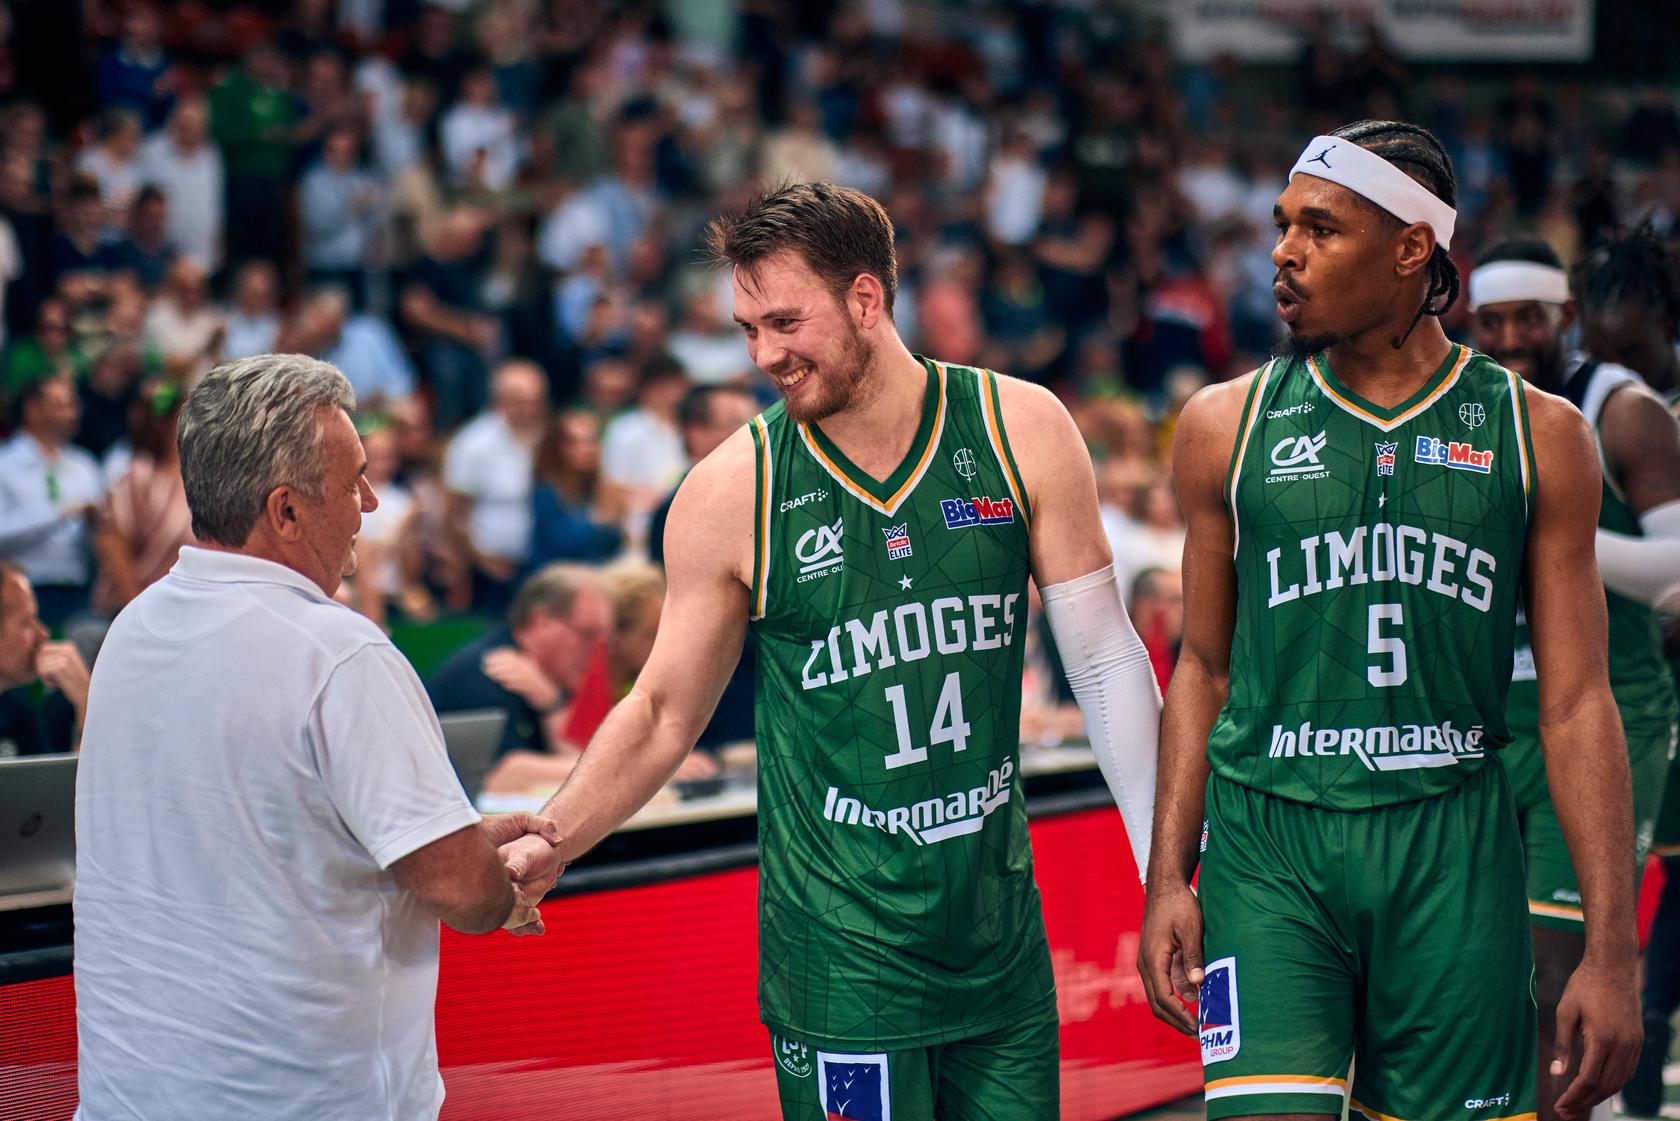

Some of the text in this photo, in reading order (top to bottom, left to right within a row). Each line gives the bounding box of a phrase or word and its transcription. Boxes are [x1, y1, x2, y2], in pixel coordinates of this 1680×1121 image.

[1266, 404, 1304, 420] CRAFT
[1415, 435, 1494, 474] BigMat
[780, 492, 817, 513] CRAFT
[940, 496, 1015, 530] BigMat
[890, 547, 911, 559] ELITE
[1266, 522, 1497, 613] LIMOGES
[801, 593, 1019, 690] LIMOGES
[1367, 603, 1408, 688] 5
[884, 671, 972, 770] 14
[1210, 1046, 1234, 1057] GROUP
[1464, 1096, 1505, 1109] CRAFT
